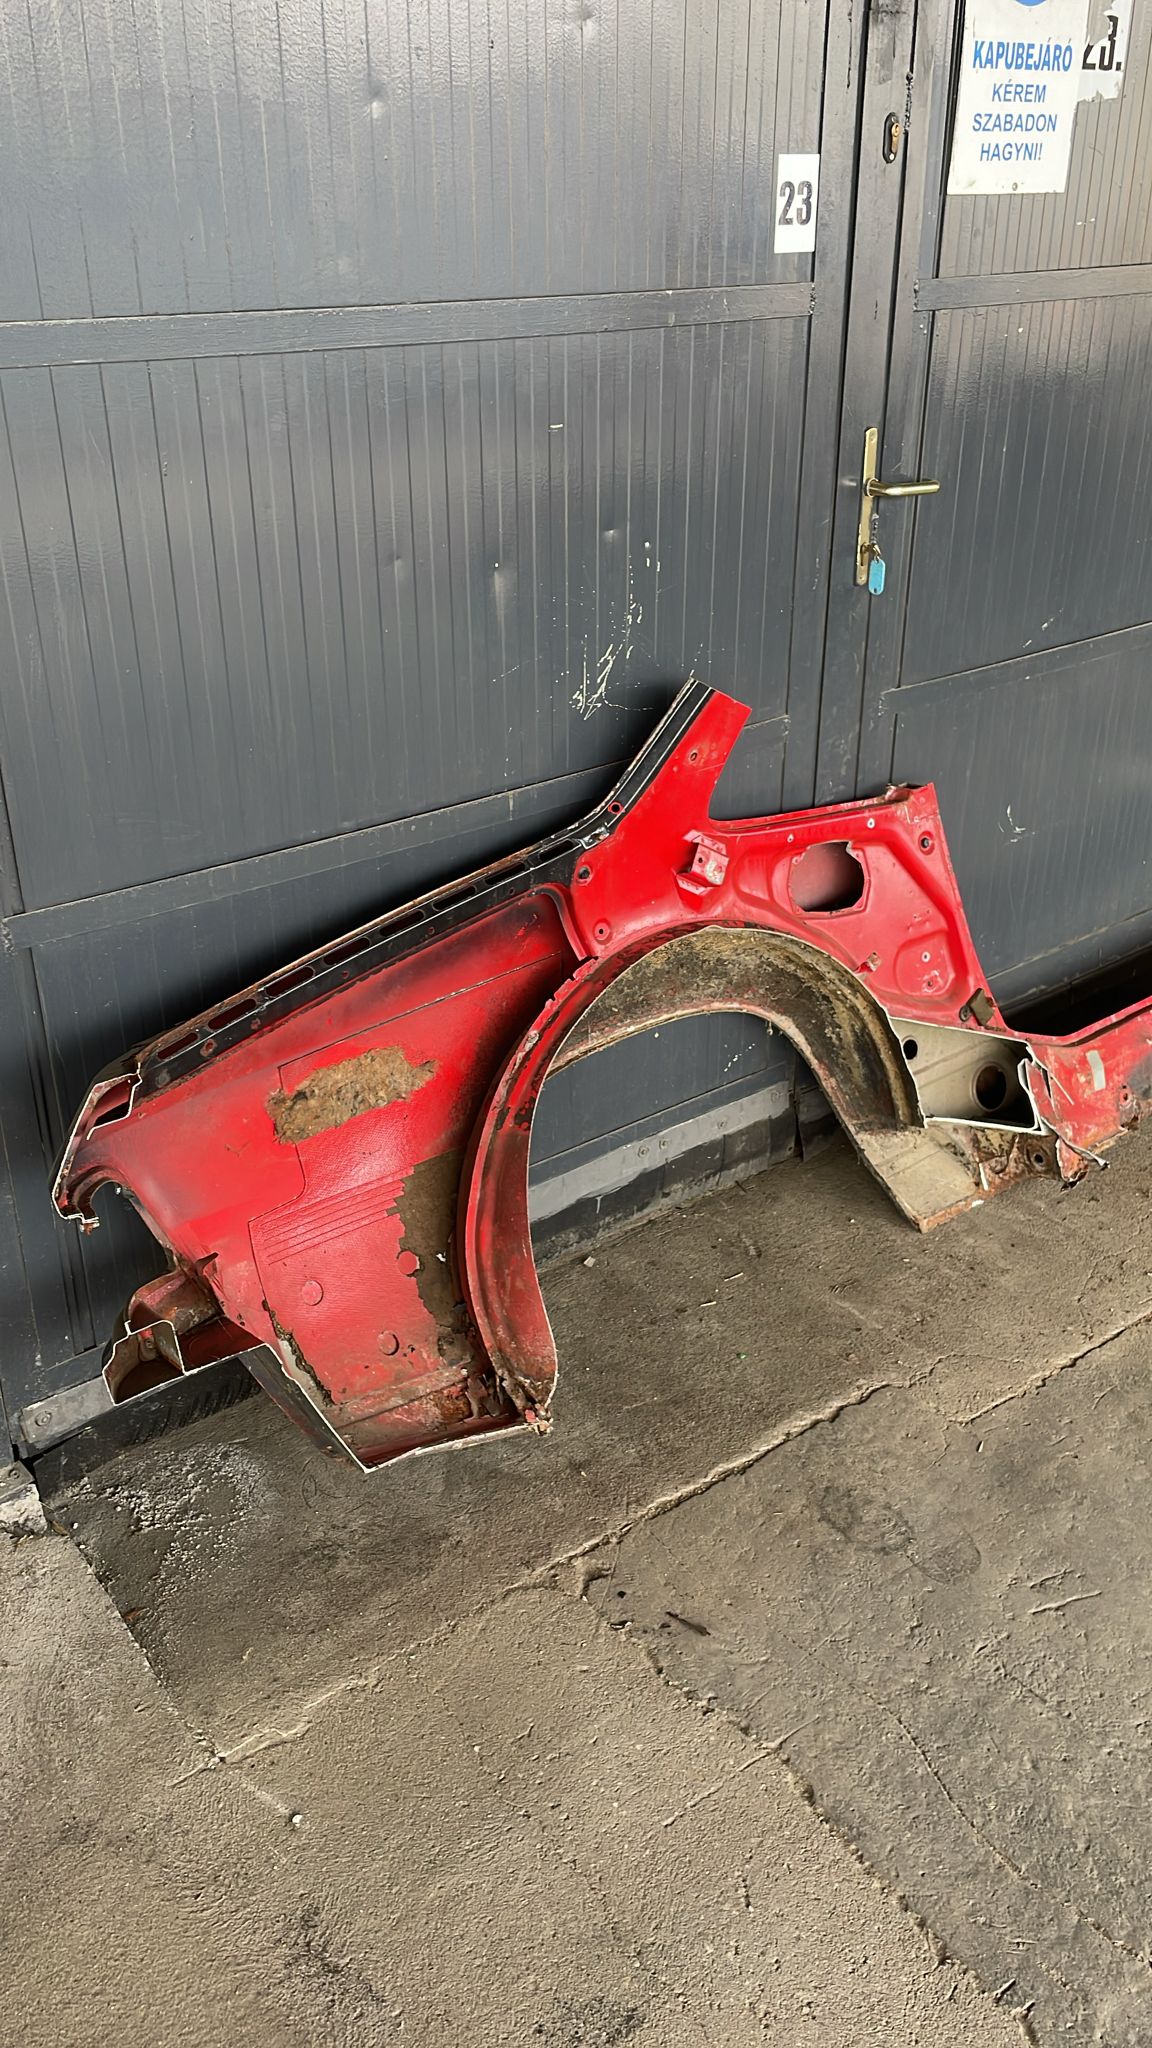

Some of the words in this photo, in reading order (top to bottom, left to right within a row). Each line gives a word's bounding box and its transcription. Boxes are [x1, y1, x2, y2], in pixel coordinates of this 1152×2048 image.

[972, 38, 1073, 72] KAPUBEJÁRÓ
[992, 79, 1046, 103] KÉREM
[972, 113, 1057, 132] SZABADON
[980, 143, 1043, 161] HAGYNI!
[778, 180, 813, 226] 23
